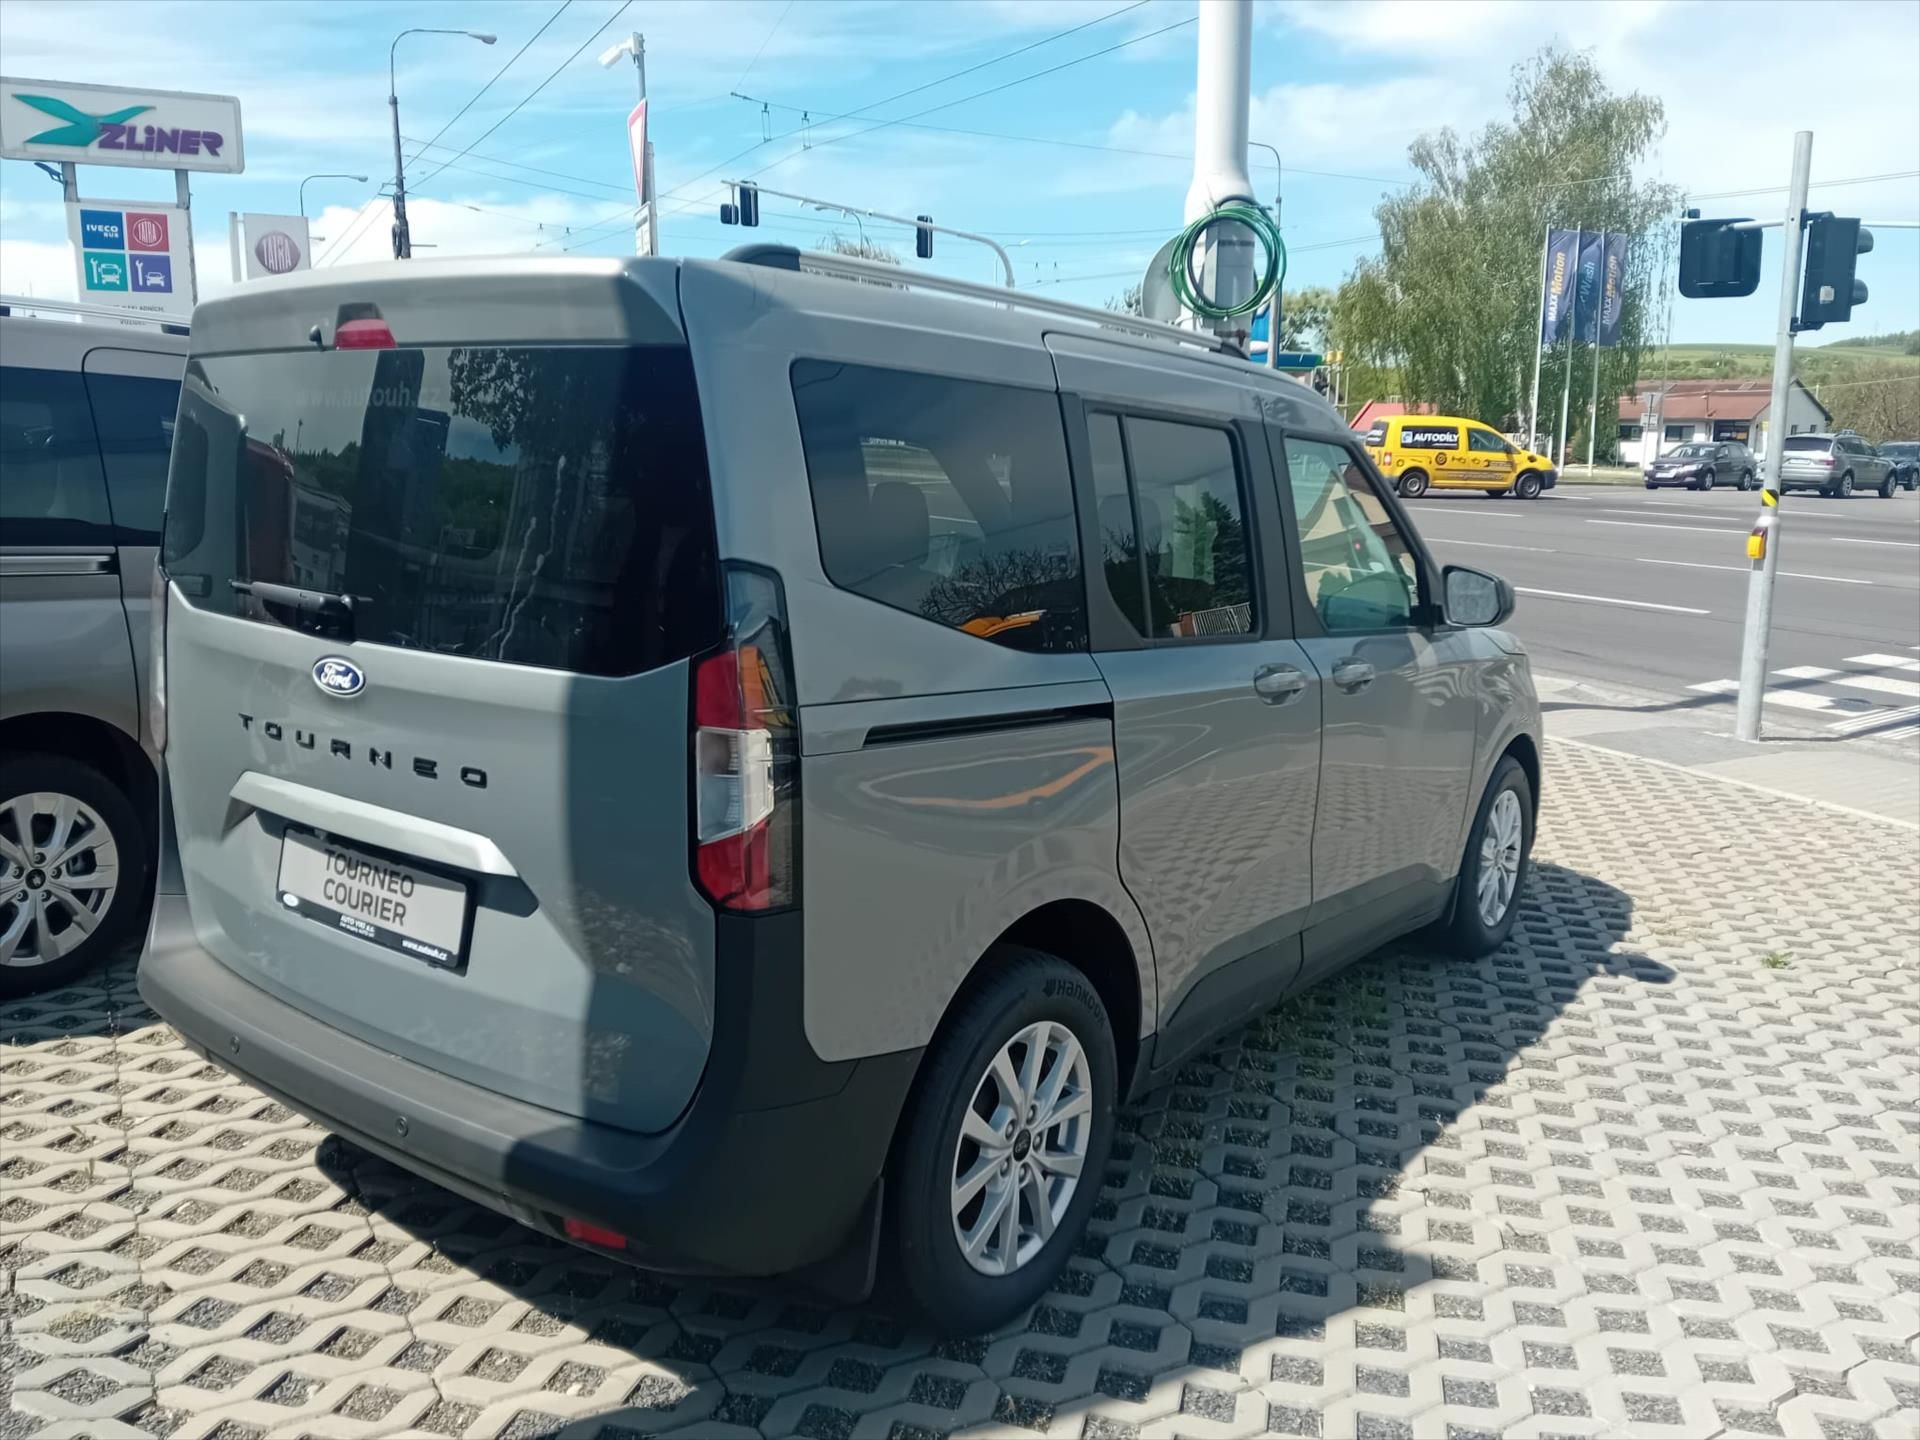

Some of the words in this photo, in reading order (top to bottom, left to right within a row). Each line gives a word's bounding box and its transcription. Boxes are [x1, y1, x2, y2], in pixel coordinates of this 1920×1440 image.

[86, 224, 119, 232] IVECO
[1413, 431, 1459, 442] AUTODÍLY
[320, 662, 353, 690] Ford
[238, 713, 488, 789] TOURNEO
[324, 848, 415, 898] TOURNEO
[323, 878, 407, 926] COURIER
